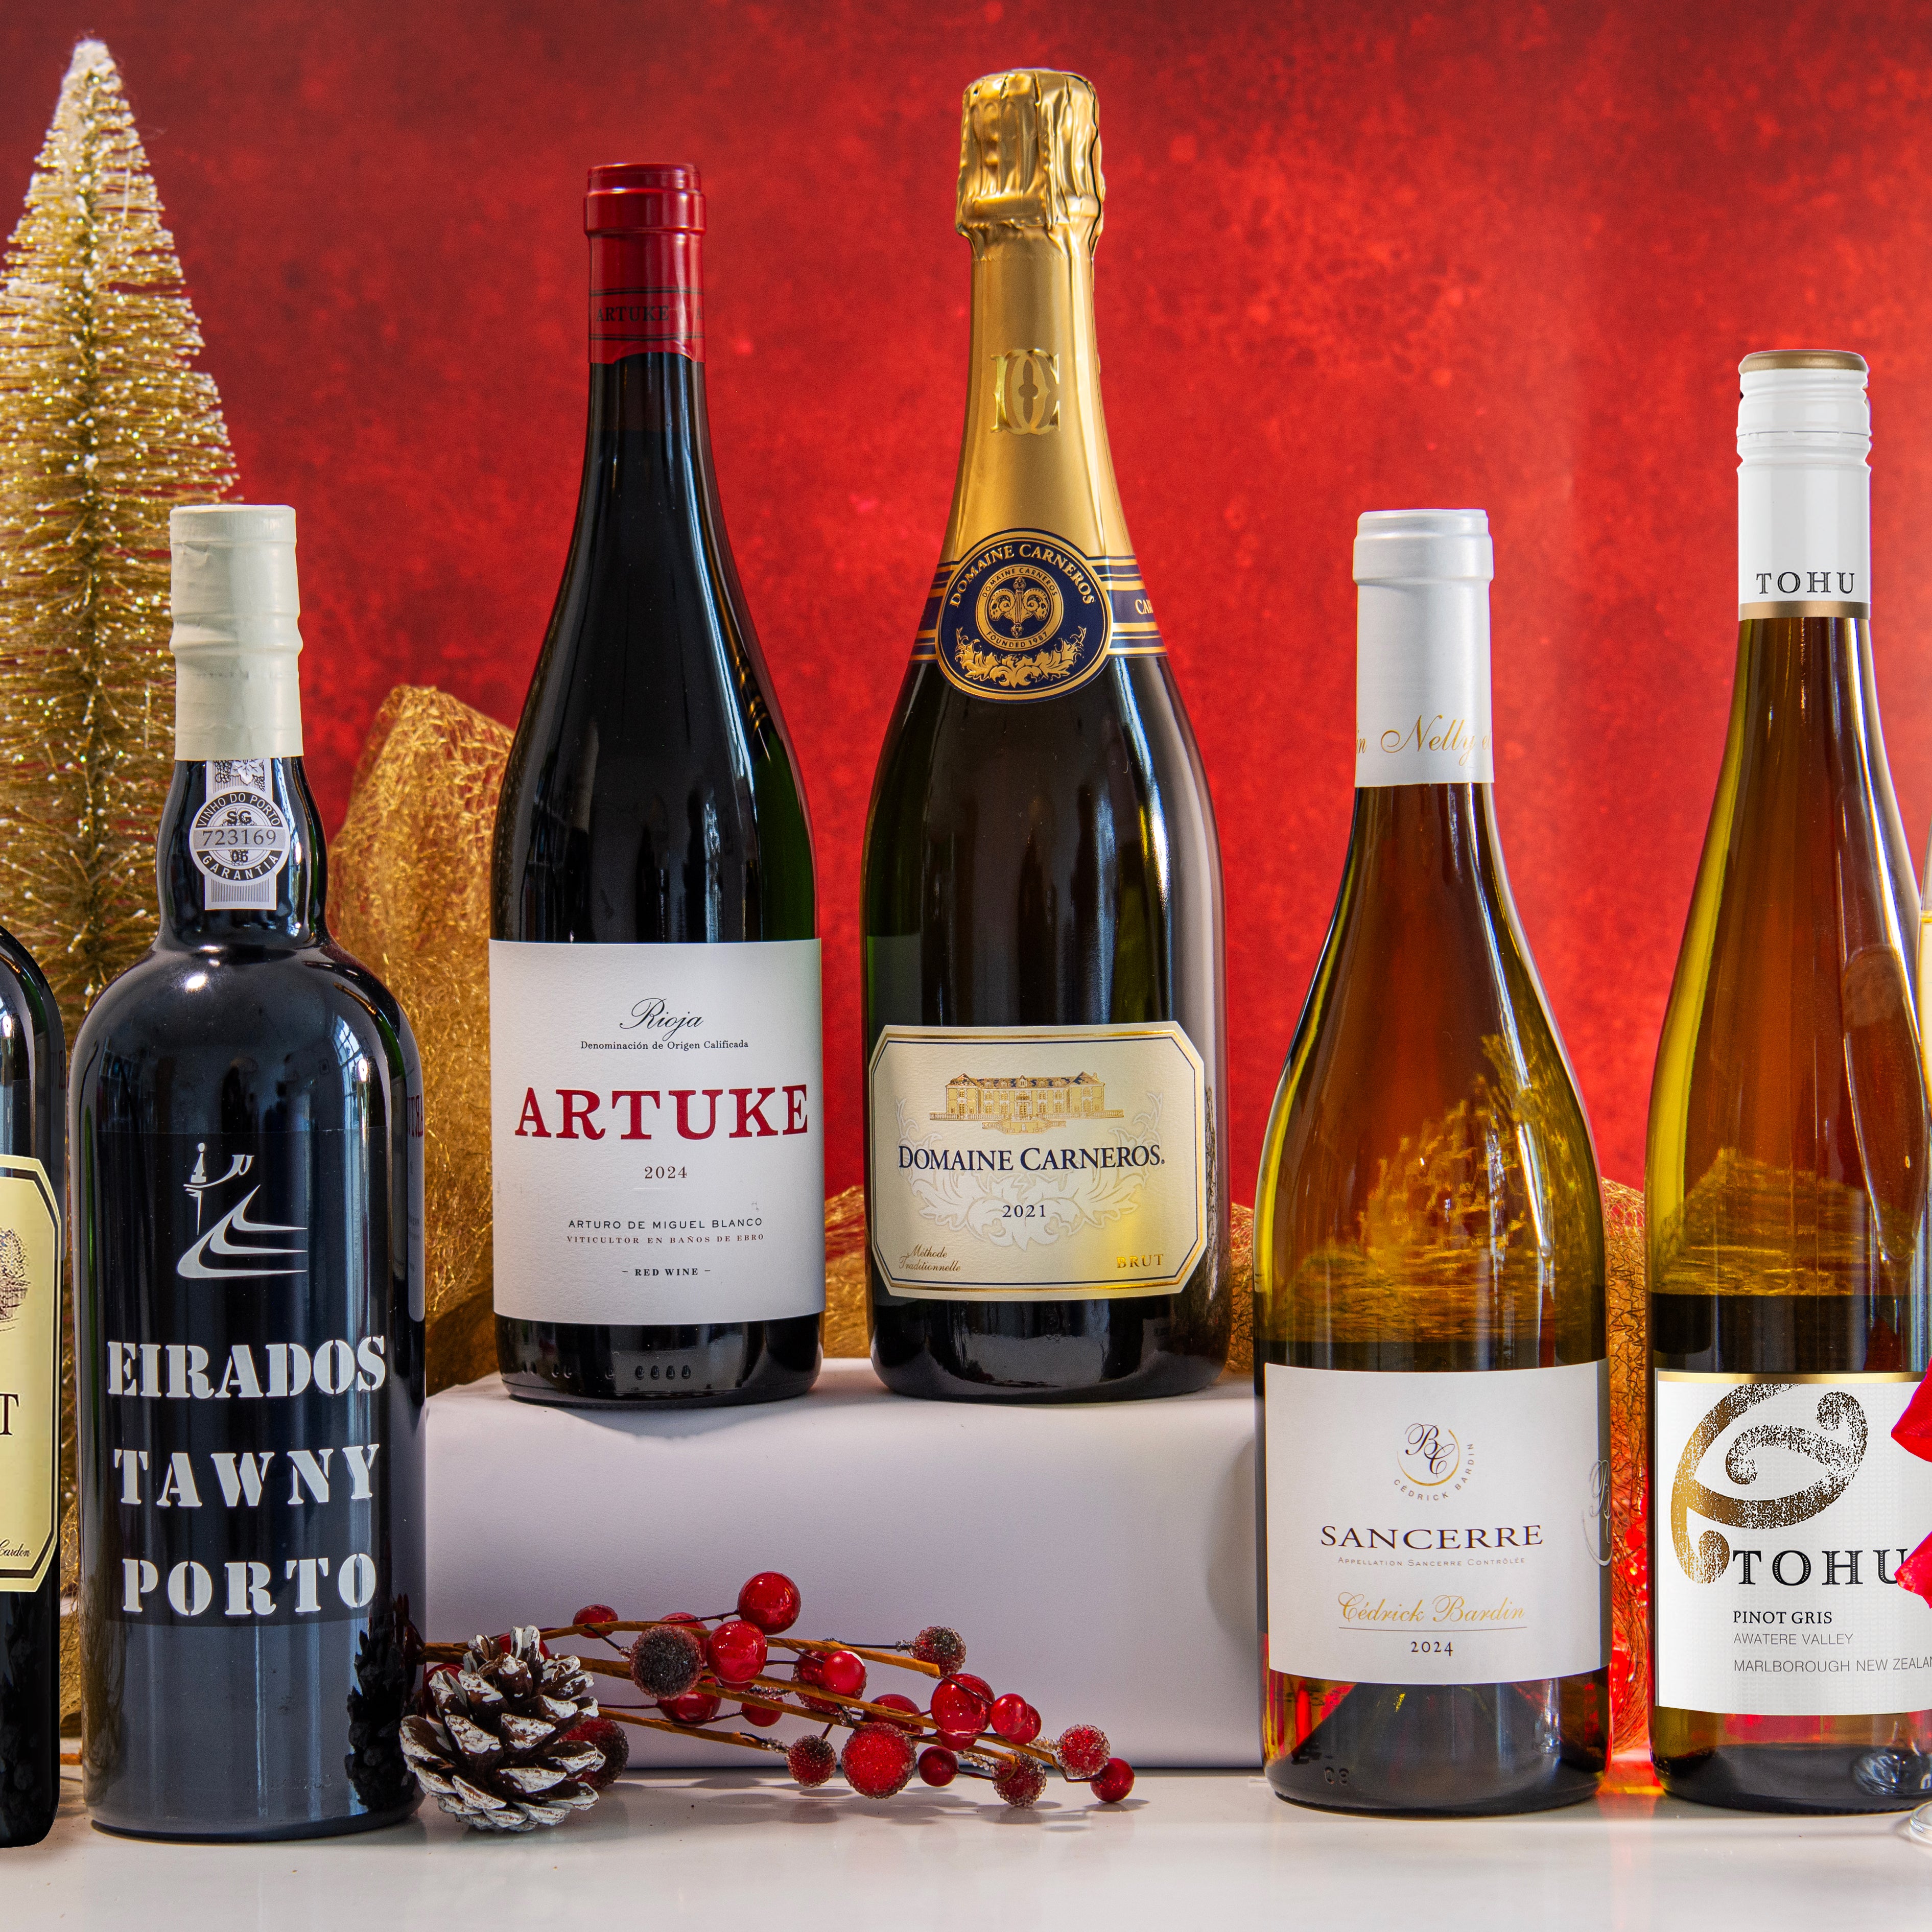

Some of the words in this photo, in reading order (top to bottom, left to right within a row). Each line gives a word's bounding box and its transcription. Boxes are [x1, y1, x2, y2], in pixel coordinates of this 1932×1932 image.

[596, 305, 669, 321] ARTUKE
[950, 546, 1015, 607] DOMAINE
[1019, 544, 1096, 605] CARNEROS
[982, 569, 1015, 597] DOMAINE
[1019, 568, 1058, 596] CARNEROS
[1756, 571, 1855, 594] TOHU
[986, 631, 1026, 648] FOUNDED
[1029, 631, 1048, 645] 1987
[1380, 715, 1476, 766] Nelly
[197, 797, 226, 827] VINHO
[230, 793, 245, 803] DO
[250, 795, 280, 826] PORTO
[226, 811, 252, 824] SG
[202, 829, 276, 846] 723169
[231, 852, 248, 862] 06
[202, 855, 278, 880] GARANTIA
[619, 997, 704, 1041] Rioja
[580, 1040, 649, 1050] Denominación
[652, 1041, 664, 1049] de
[667, 1040, 700, 1051] Origen
[703, 1039, 749, 1050] Calificada
[514, 1084, 808, 1140] ARTUKE
[899, 1145, 1014, 1171] DOMAINE
[644, 1166, 688, 1180] 2024
[1002, 1204, 1047, 1217] 2021
[568, 1220, 621, 1229] ARTURO
[628, 1221, 645, 1229] DE
[653, 1220, 705, 1229] MIGUEL
[712, 1218, 762, 1228] BLANCO
[670, 1235, 711, 1243] BAÑOS
[907, 1244, 948, 1258] Méthode
[899, 1256, 961, 1272] Traditionnelle
[1117, 1254, 1164, 1269] BRUT
[107, 1336, 387, 1399] EIRADOS
[114, 1444, 380, 1507] TAWNY
[1394, 1479, 1449, 1501] CÉDRICK
[1455, 1444, 1475, 1490] BARDIN
[1321, 1525, 1543, 1549] SANCERRE
[1337, 1557, 1403, 1566] APPELLATION
[1467, 1557, 1525, 1566] CONTRÔLÉE
[1733, 1548, 1908, 1586] TOHU
[122, 1553, 376, 1616] PORTO
[1338, 1591, 1425, 1623] Cédrick
[1432, 1594, 1525, 1623] Bardin
[1733, 1611, 1786, 1624] PINOT
[1791, 1611, 1832, 1624] GRIS
[1734, 1633, 1797, 1645] AWATERE
[1802, 1633, 1853, 1645] VALLEY
[1411, 1641, 1454, 1657] 2024
[1734, 1660, 1850, 1672] MARLBOROUGH
[1856, 1659, 1888, 1671] NEW
